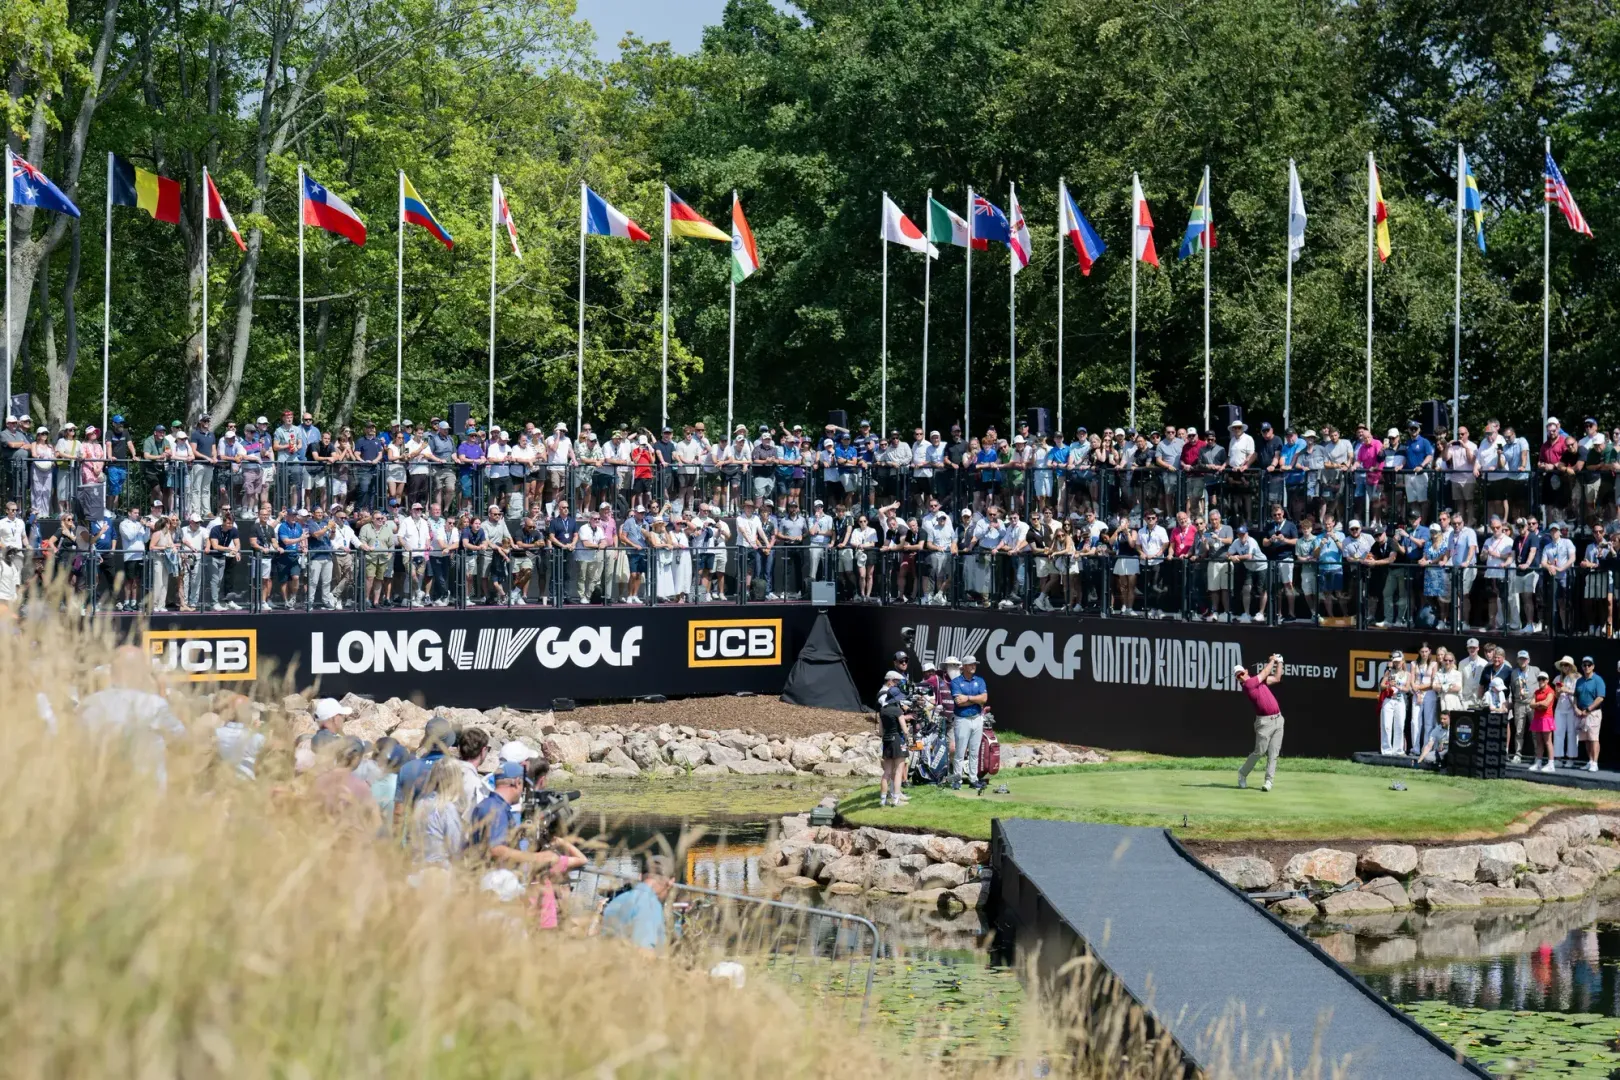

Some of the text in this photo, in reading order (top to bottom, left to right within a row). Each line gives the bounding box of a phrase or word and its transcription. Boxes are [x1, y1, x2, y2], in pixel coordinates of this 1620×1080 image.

[152, 639, 247, 671] JCB
[311, 625, 643, 674] LONG LIV GOLF
[696, 628, 774, 658] JCB
[986, 629, 1083, 680] GOLF
[1091, 635, 1151, 685] UNITED
[1155, 638, 1243, 692] KINGDOM
[1323, 666, 1338, 679] BY
